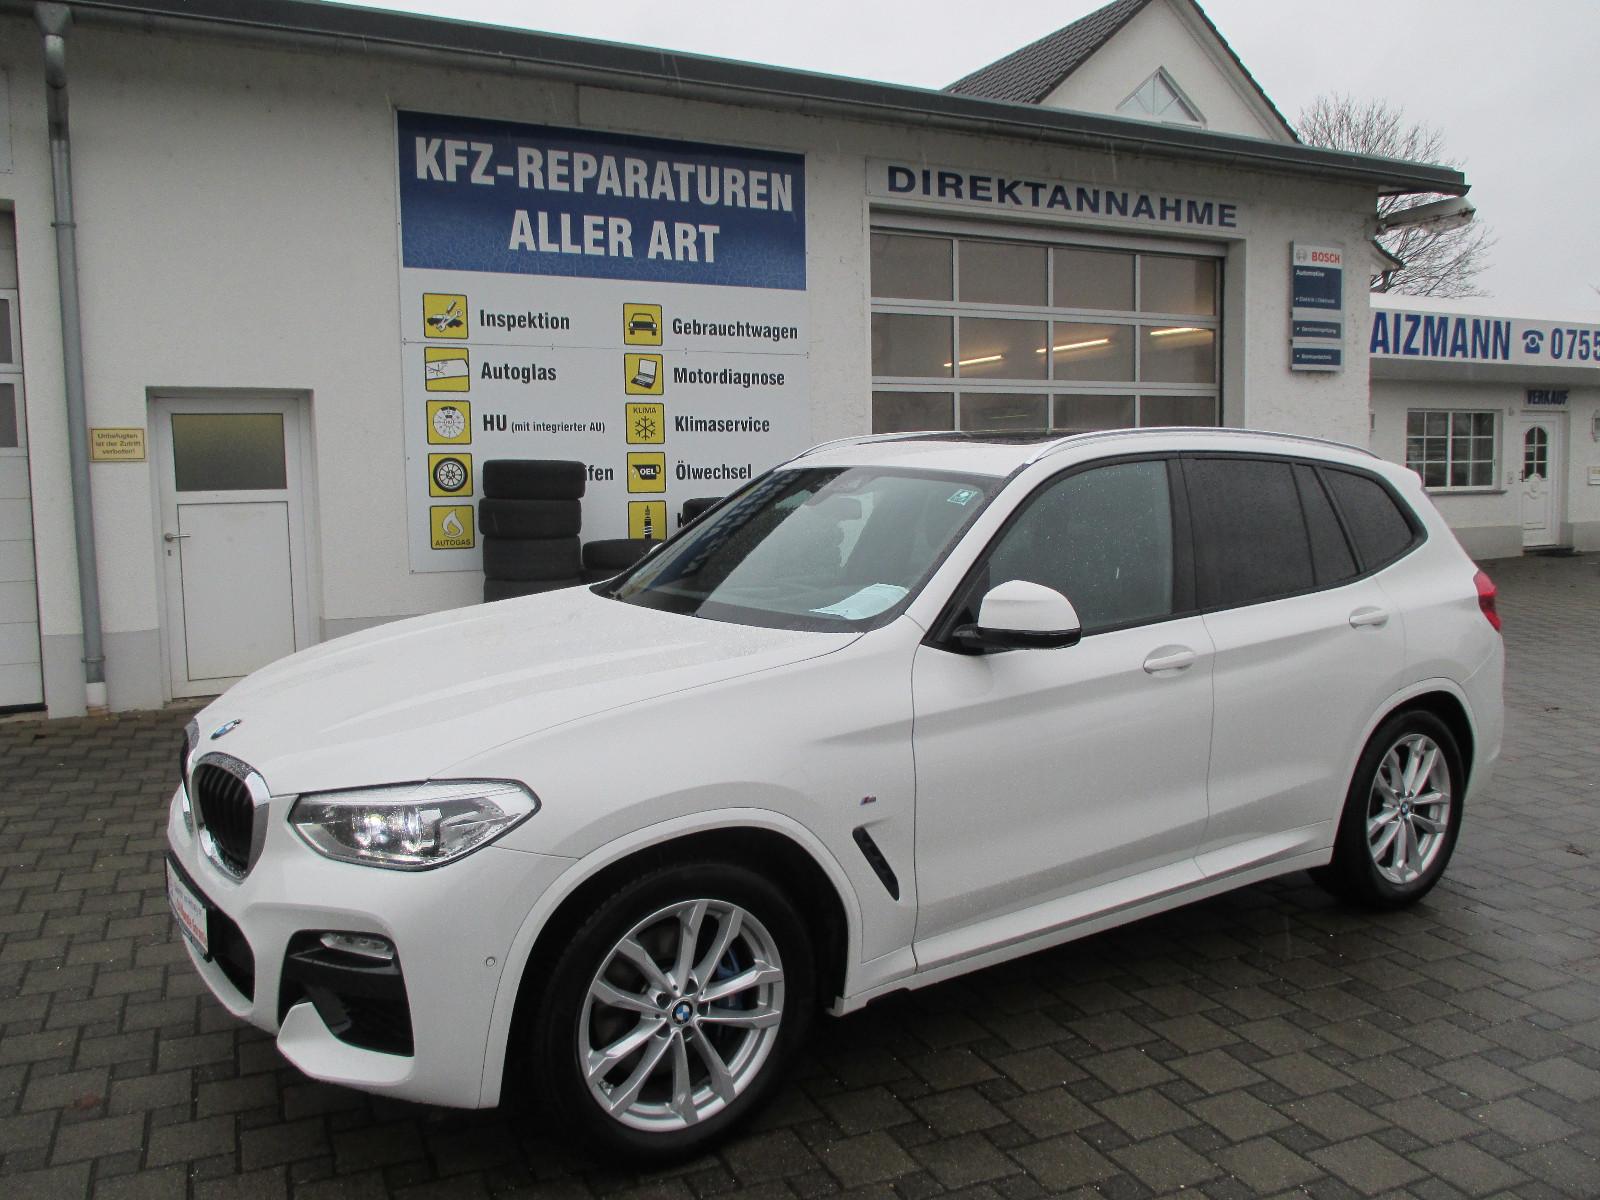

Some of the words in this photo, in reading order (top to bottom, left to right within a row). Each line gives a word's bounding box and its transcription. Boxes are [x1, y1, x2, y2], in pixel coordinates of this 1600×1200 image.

[415, 136, 793, 212] KFZ-REPARATUREN
[887, 165, 1237, 228] DIREKTANNAHME
[508, 209, 633, 258] ALLER
[647, 220, 720, 263] ART
[1311, 251, 1341, 264] BOSCH
[479, 309, 571, 331] Inspektion
[672, 318, 798, 341] Gebrauchtwagen
[1370, 311, 1511, 361] AIZMANN
[480, 362, 557, 382] Autoglas
[673, 367, 785, 387] Motordiagnose
[1527, 389, 1569, 405] VERKAUF
[483, 414, 507, 431] HU
[511, 422, 530, 433] (mit
[533, 422, 586, 433] integrierter
[589, 422, 606, 433] AU)
[675, 415, 770, 433] Klimaservice
[675, 460, 752, 480] Ölwechsel
